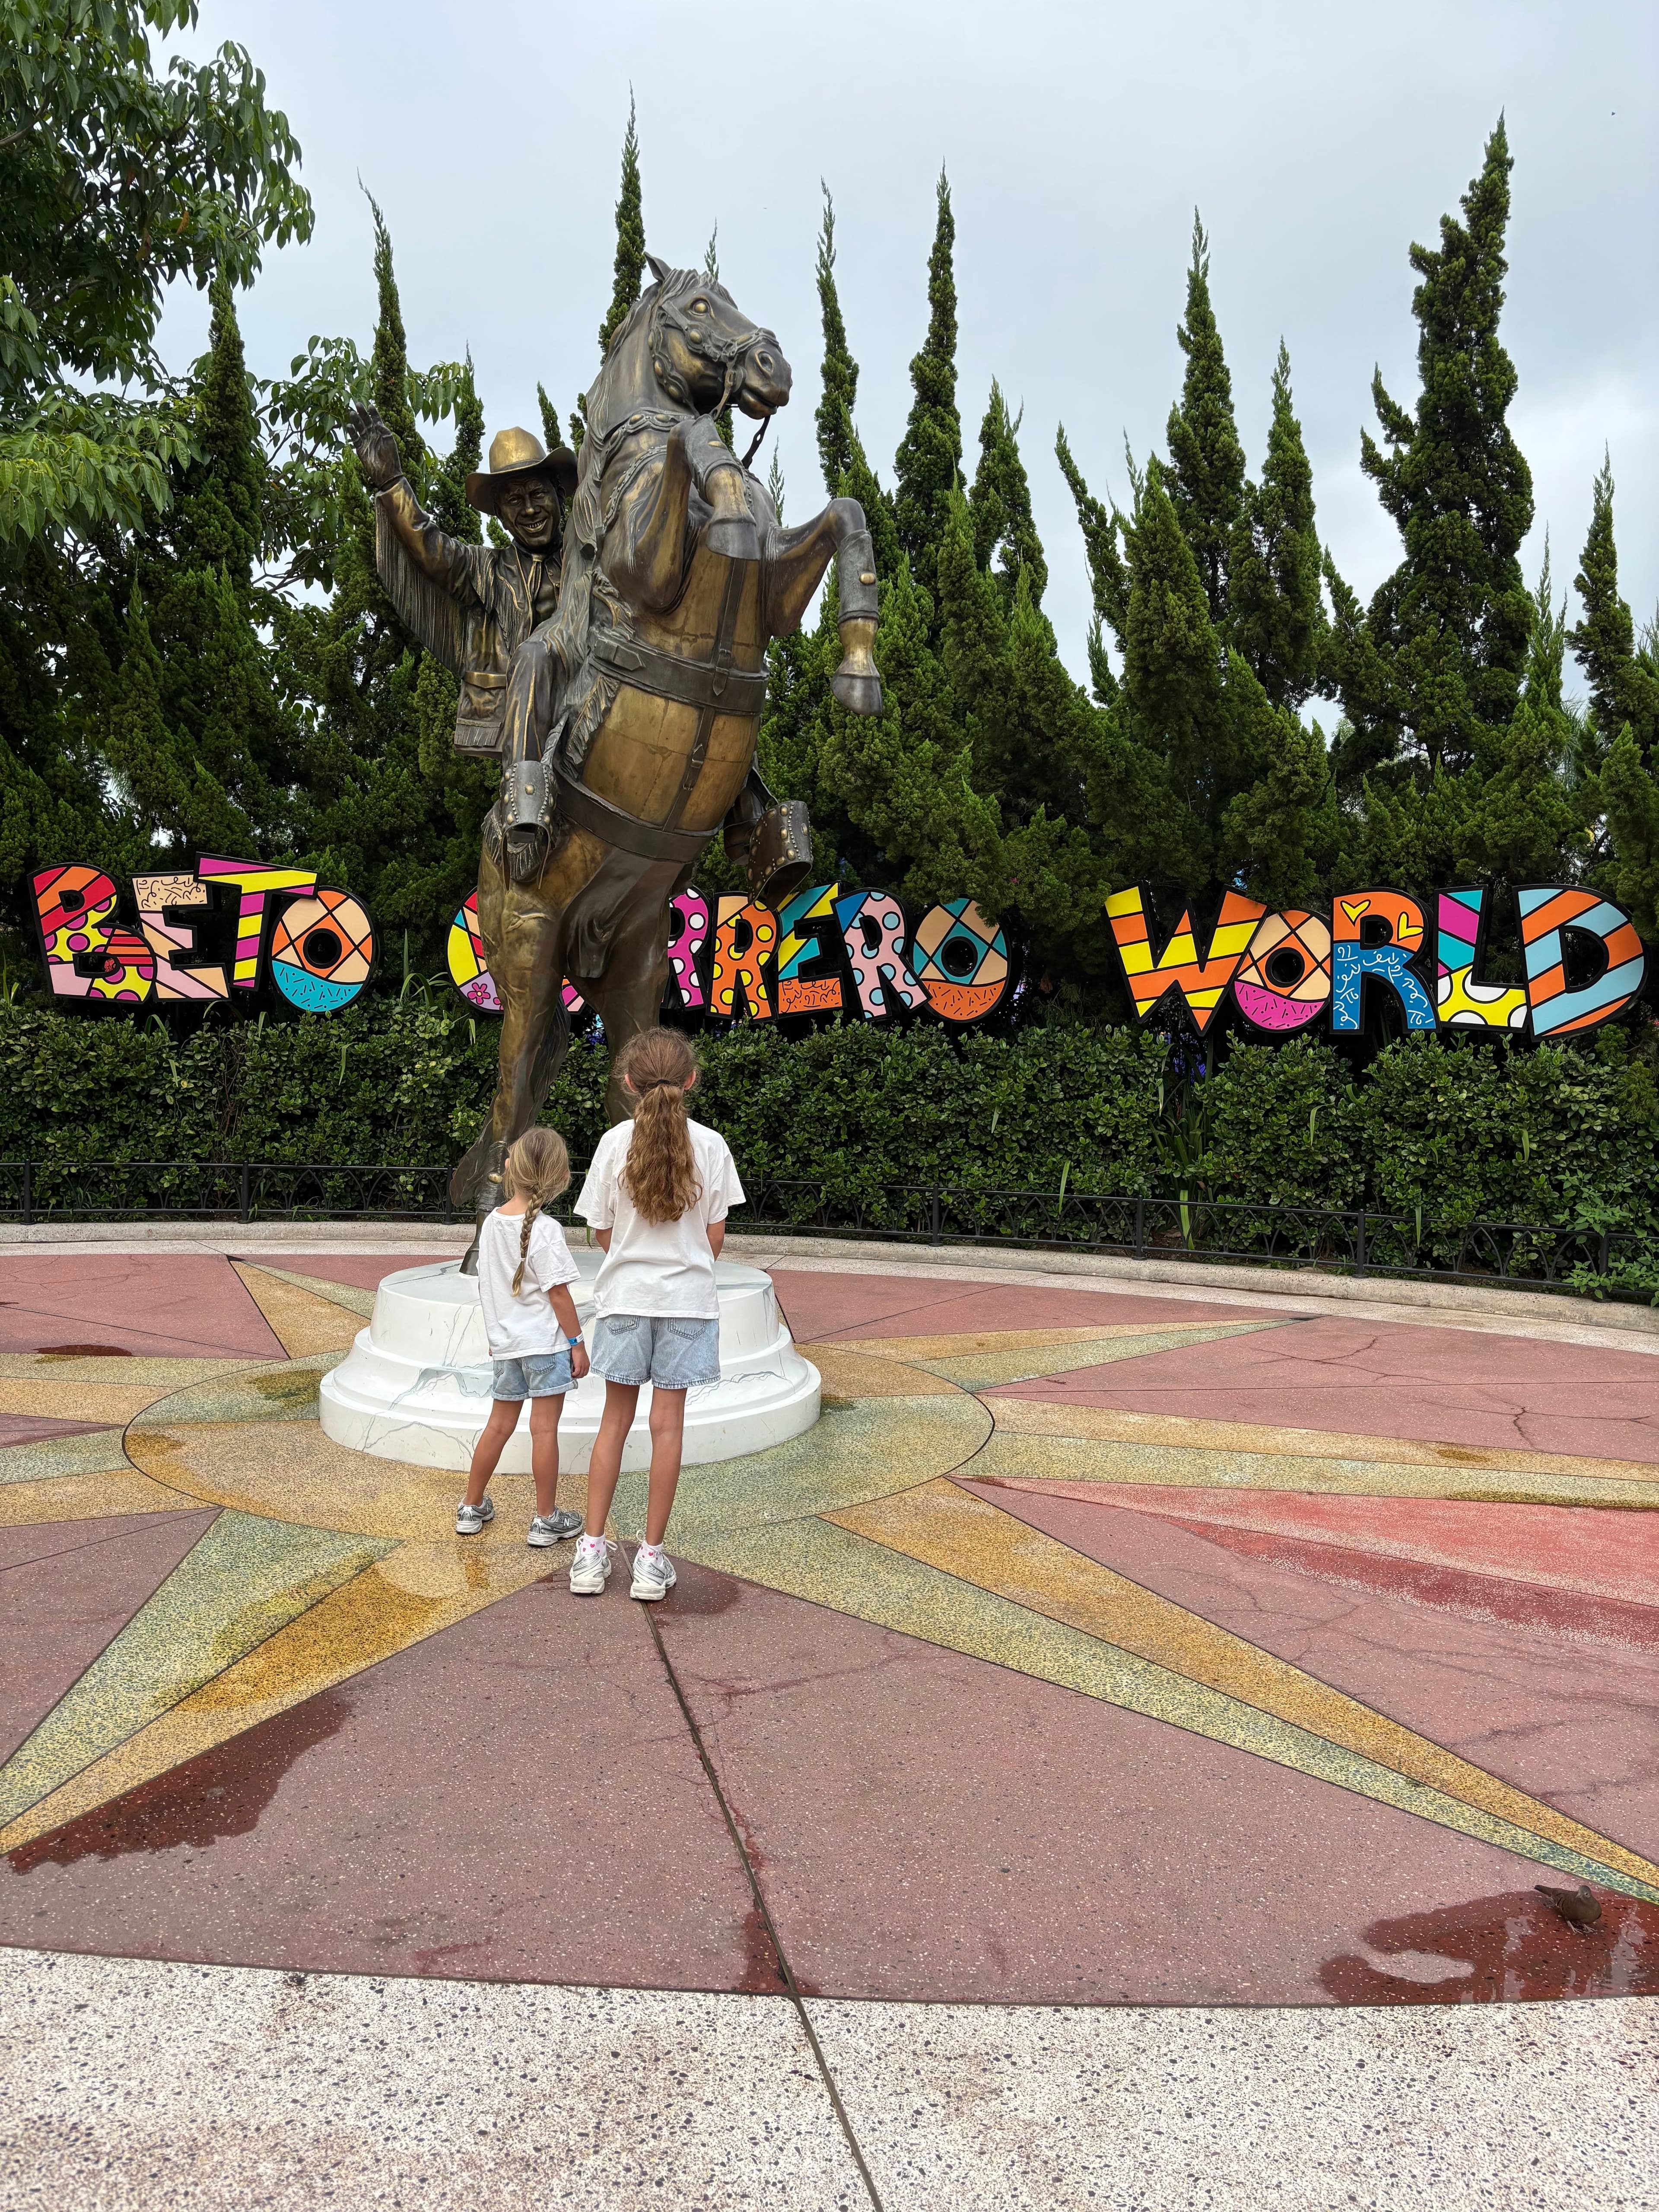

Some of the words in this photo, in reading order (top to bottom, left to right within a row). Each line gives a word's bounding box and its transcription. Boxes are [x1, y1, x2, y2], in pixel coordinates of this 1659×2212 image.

[28, 852, 377, 1014] BETO
[445, 881, 1011, 1023] CRRERO
[1104, 880, 1648, 1037] WORLD
[563, 1517, 569, 1527] N
